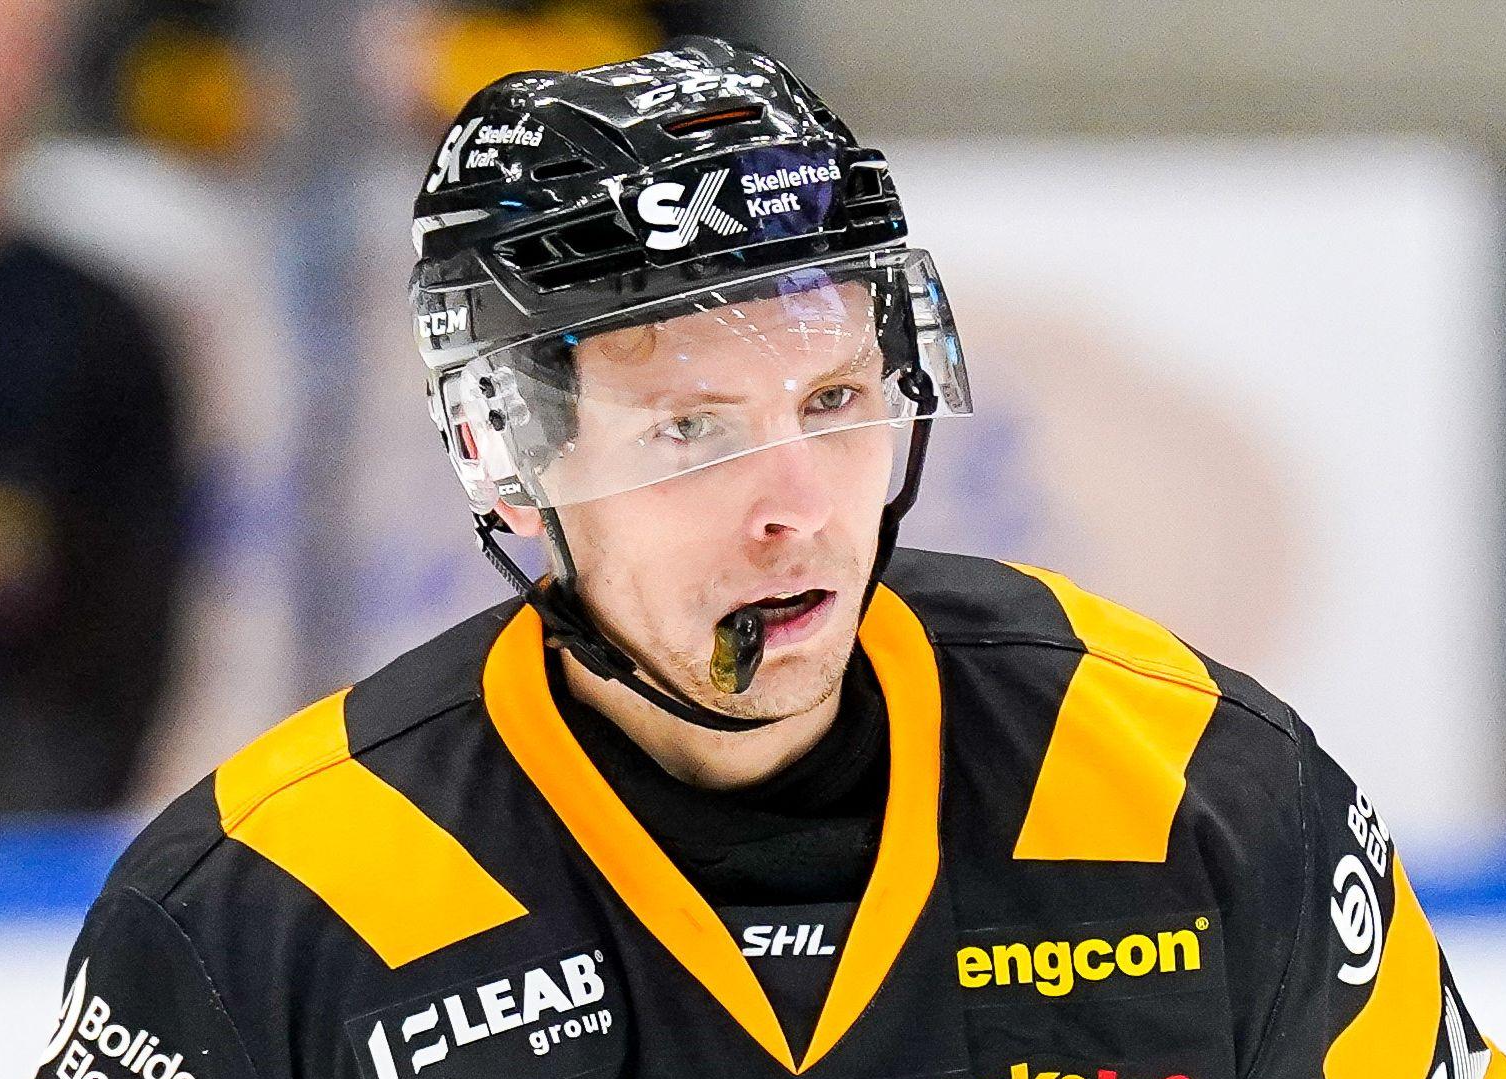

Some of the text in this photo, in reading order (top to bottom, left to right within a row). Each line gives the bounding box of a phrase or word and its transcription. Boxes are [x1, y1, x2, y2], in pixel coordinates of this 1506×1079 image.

[741, 158, 842, 196] Skellefteå
[746, 191, 801, 218] Kraft
[418, 307, 468, 338] CCM
[742, 923, 836, 957] SHL
[528, 1008, 613, 1057] group
